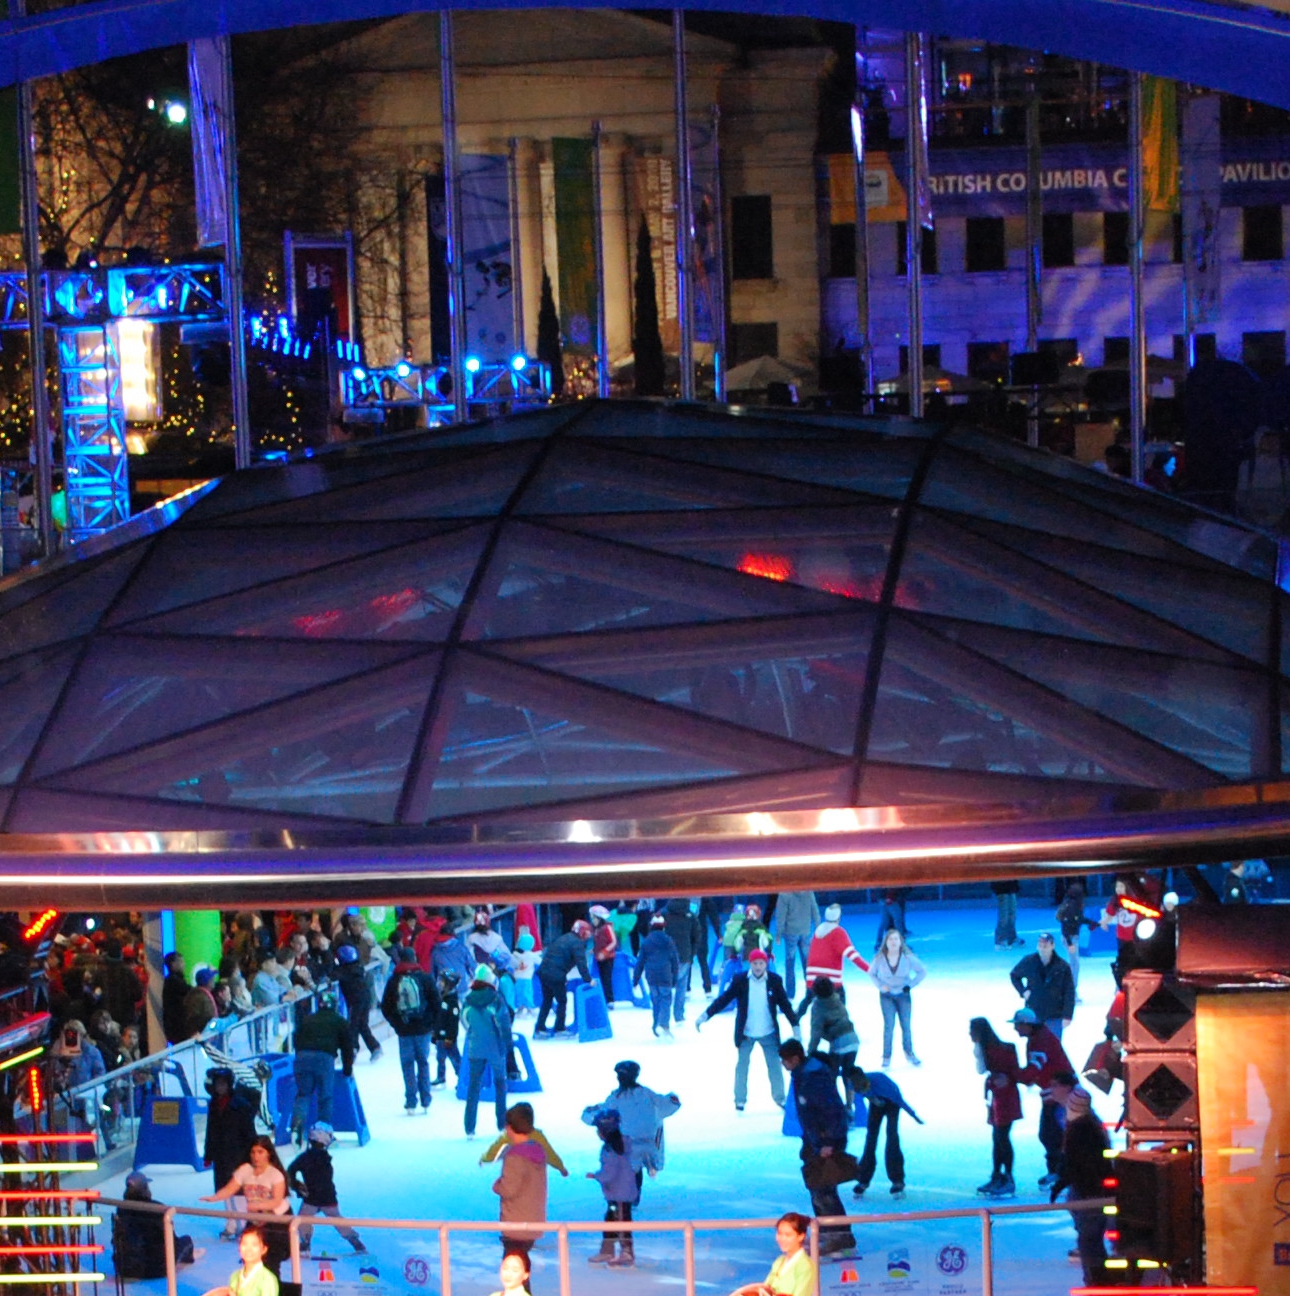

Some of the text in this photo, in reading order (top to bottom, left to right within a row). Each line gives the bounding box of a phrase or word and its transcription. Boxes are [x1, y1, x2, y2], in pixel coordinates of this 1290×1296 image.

[928, 174, 992, 195] RITISH
[996, 168, 1108, 192] COUMBIA
[661, 217, 676, 242] ART
[662, 246, 678, 320] VANCOUVER
